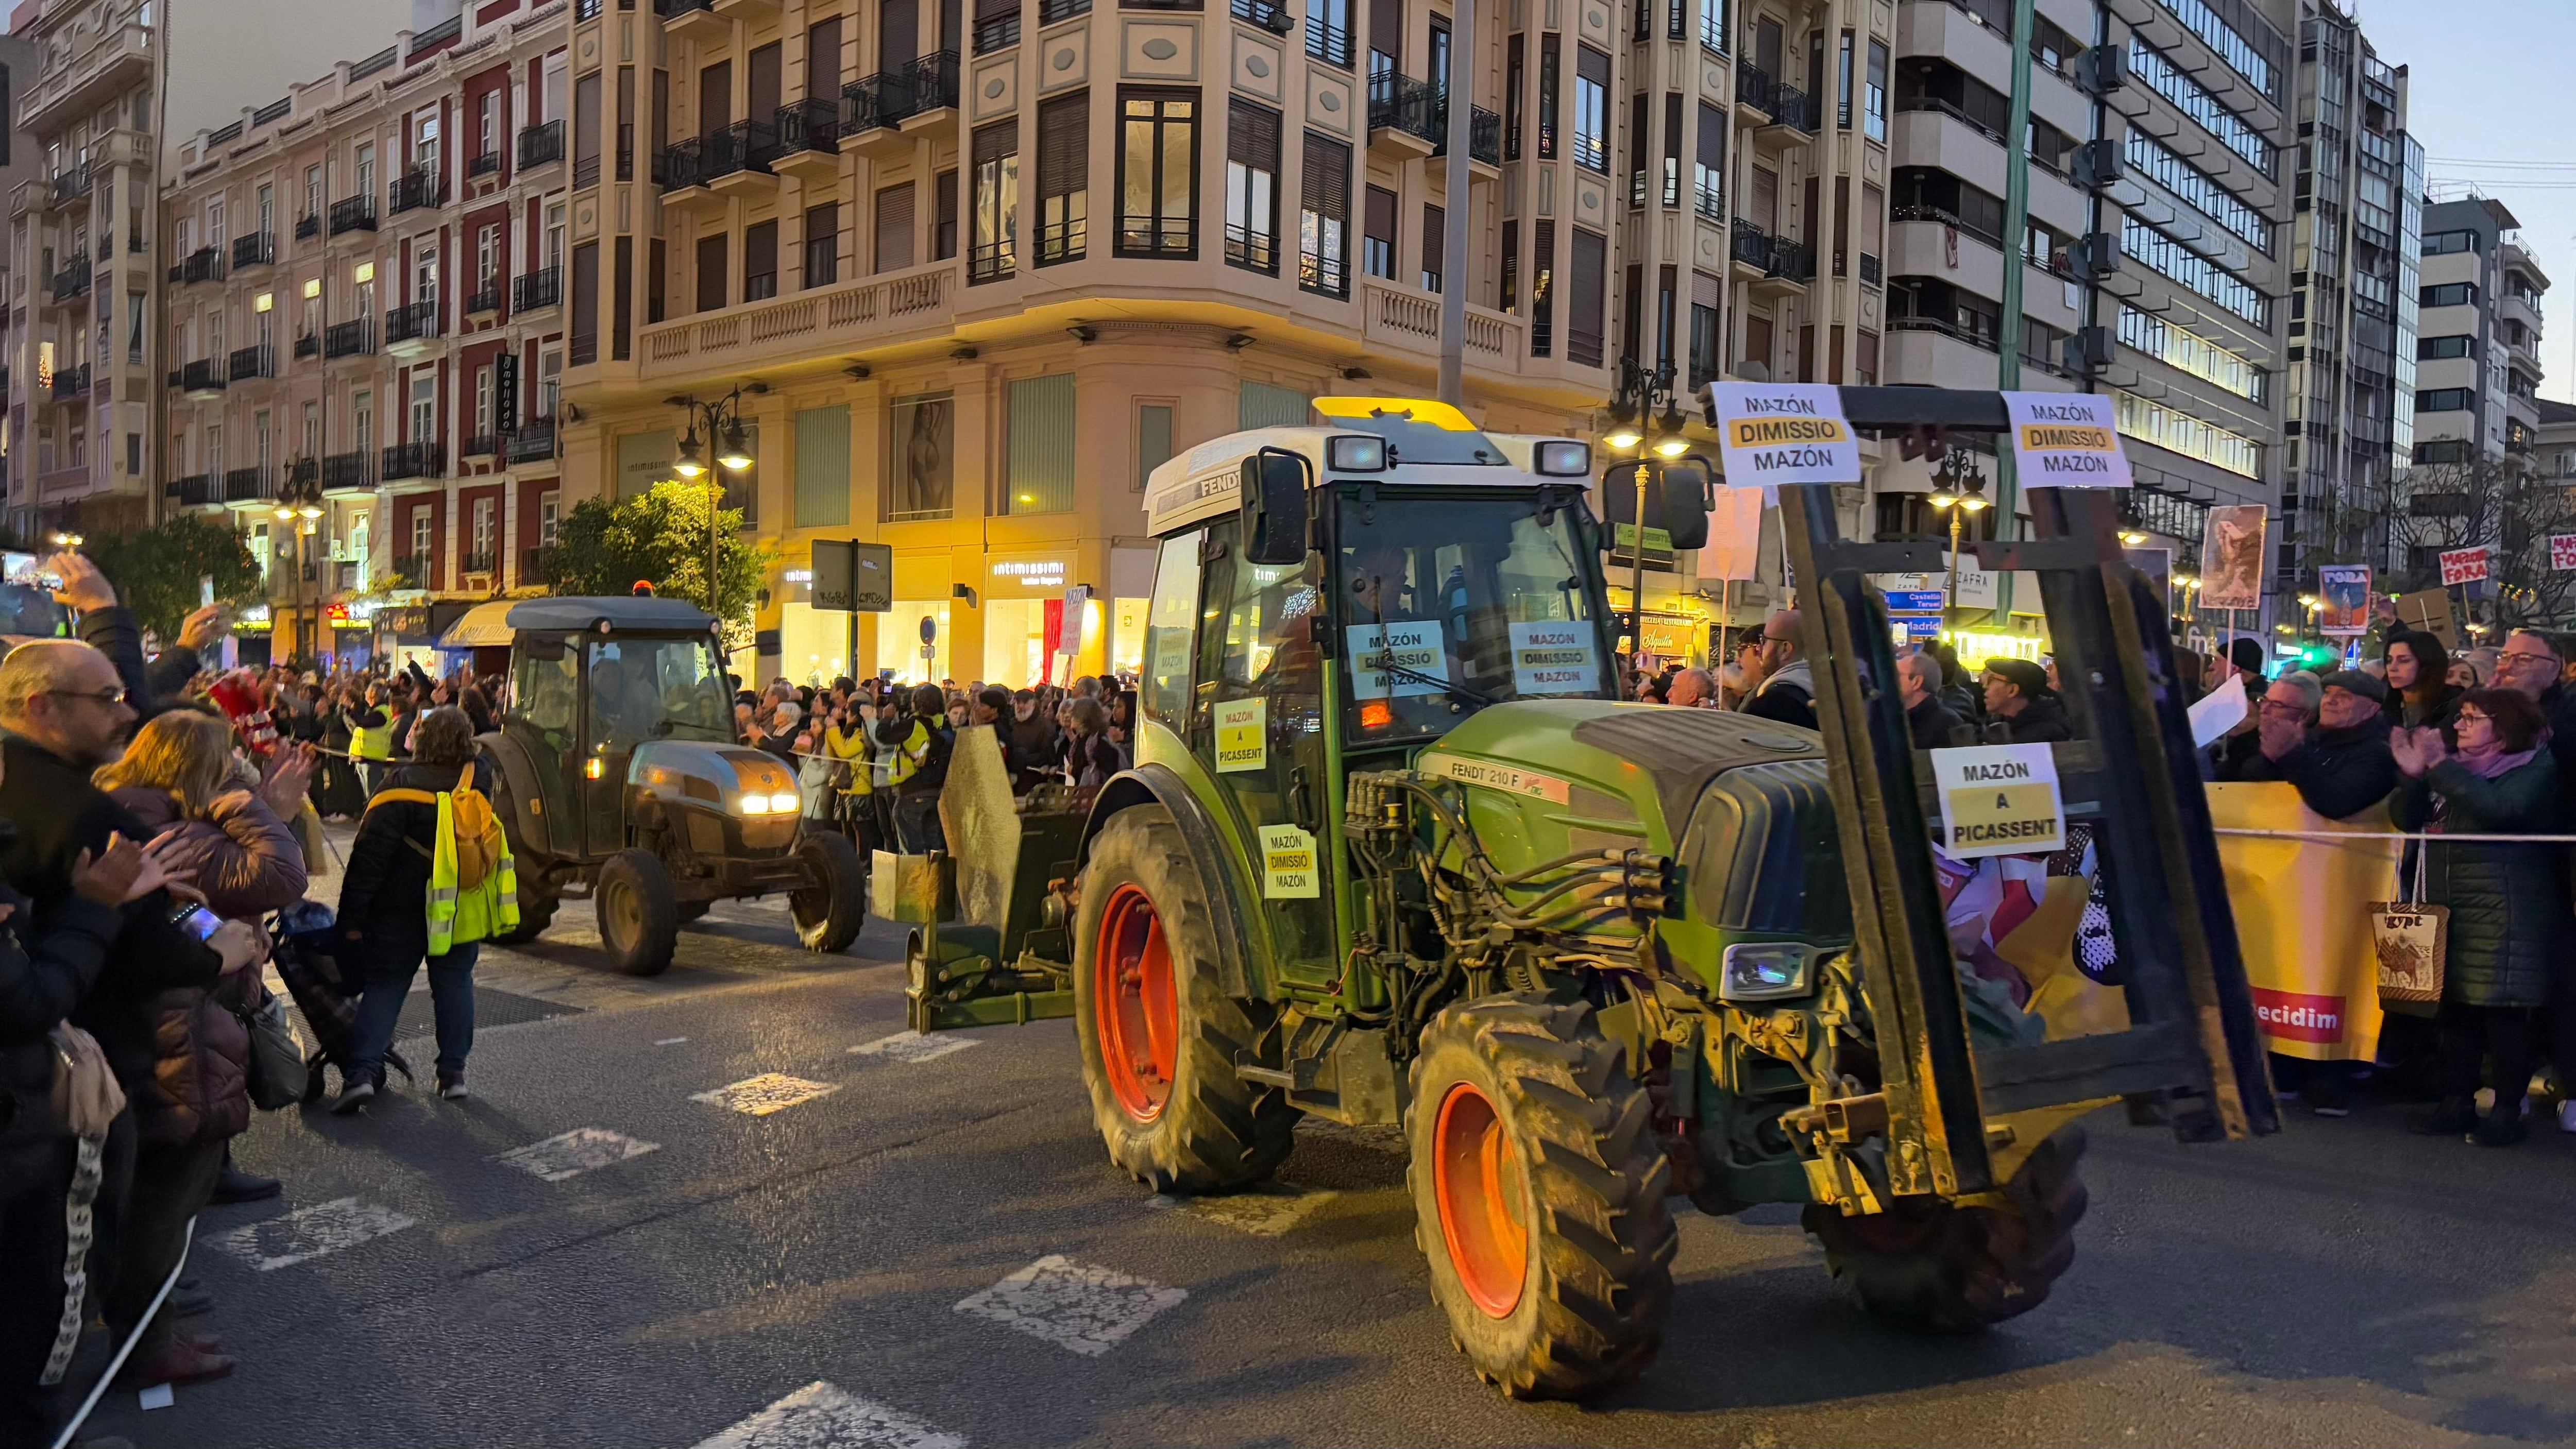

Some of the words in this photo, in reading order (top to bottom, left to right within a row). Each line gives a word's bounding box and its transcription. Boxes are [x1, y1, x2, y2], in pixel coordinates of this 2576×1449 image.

[1745, 393, 1817, 415] MAZÓN
[2031, 402, 2094, 422] MAZÓN
[1740, 418, 1835, 444] DIMISSIÓ
[2030, 427, 2107, 448] DIMISSIÓ
[1754, 444, 1833, 471] MAZÓN
[2043, 451, 2108, 472] MAZÓN
[994, 562, 1064, 575] intimissimi
[2444, 564, 2486, 583] FORA
[1957, 571, 1988, 587] ZAFRA
[1525, 650, 1583, 664] DIMISSIÓ
[1237, 730, 1243, 742] A
[1219, 747, 1262, 761] PICASSENT
[1452, 762, 1486, 780] FENDT
[1489, 770, 1509, 786] 210
[1511, 774, 1519, 787] F
[1963, 759, 2029, 782] MAZÓN
[1996, 793, 2010, 809] A
[1953, 818, 2057, 843] PICASSENT
[1270, 832, 1302, 849] MAZÓN
[1271, 851, 1308, 868] DIMISSIÓ
[1276, 872, 1306, 888] MAZÓN
[2257, 1005, 2337, 1029] ecidim
